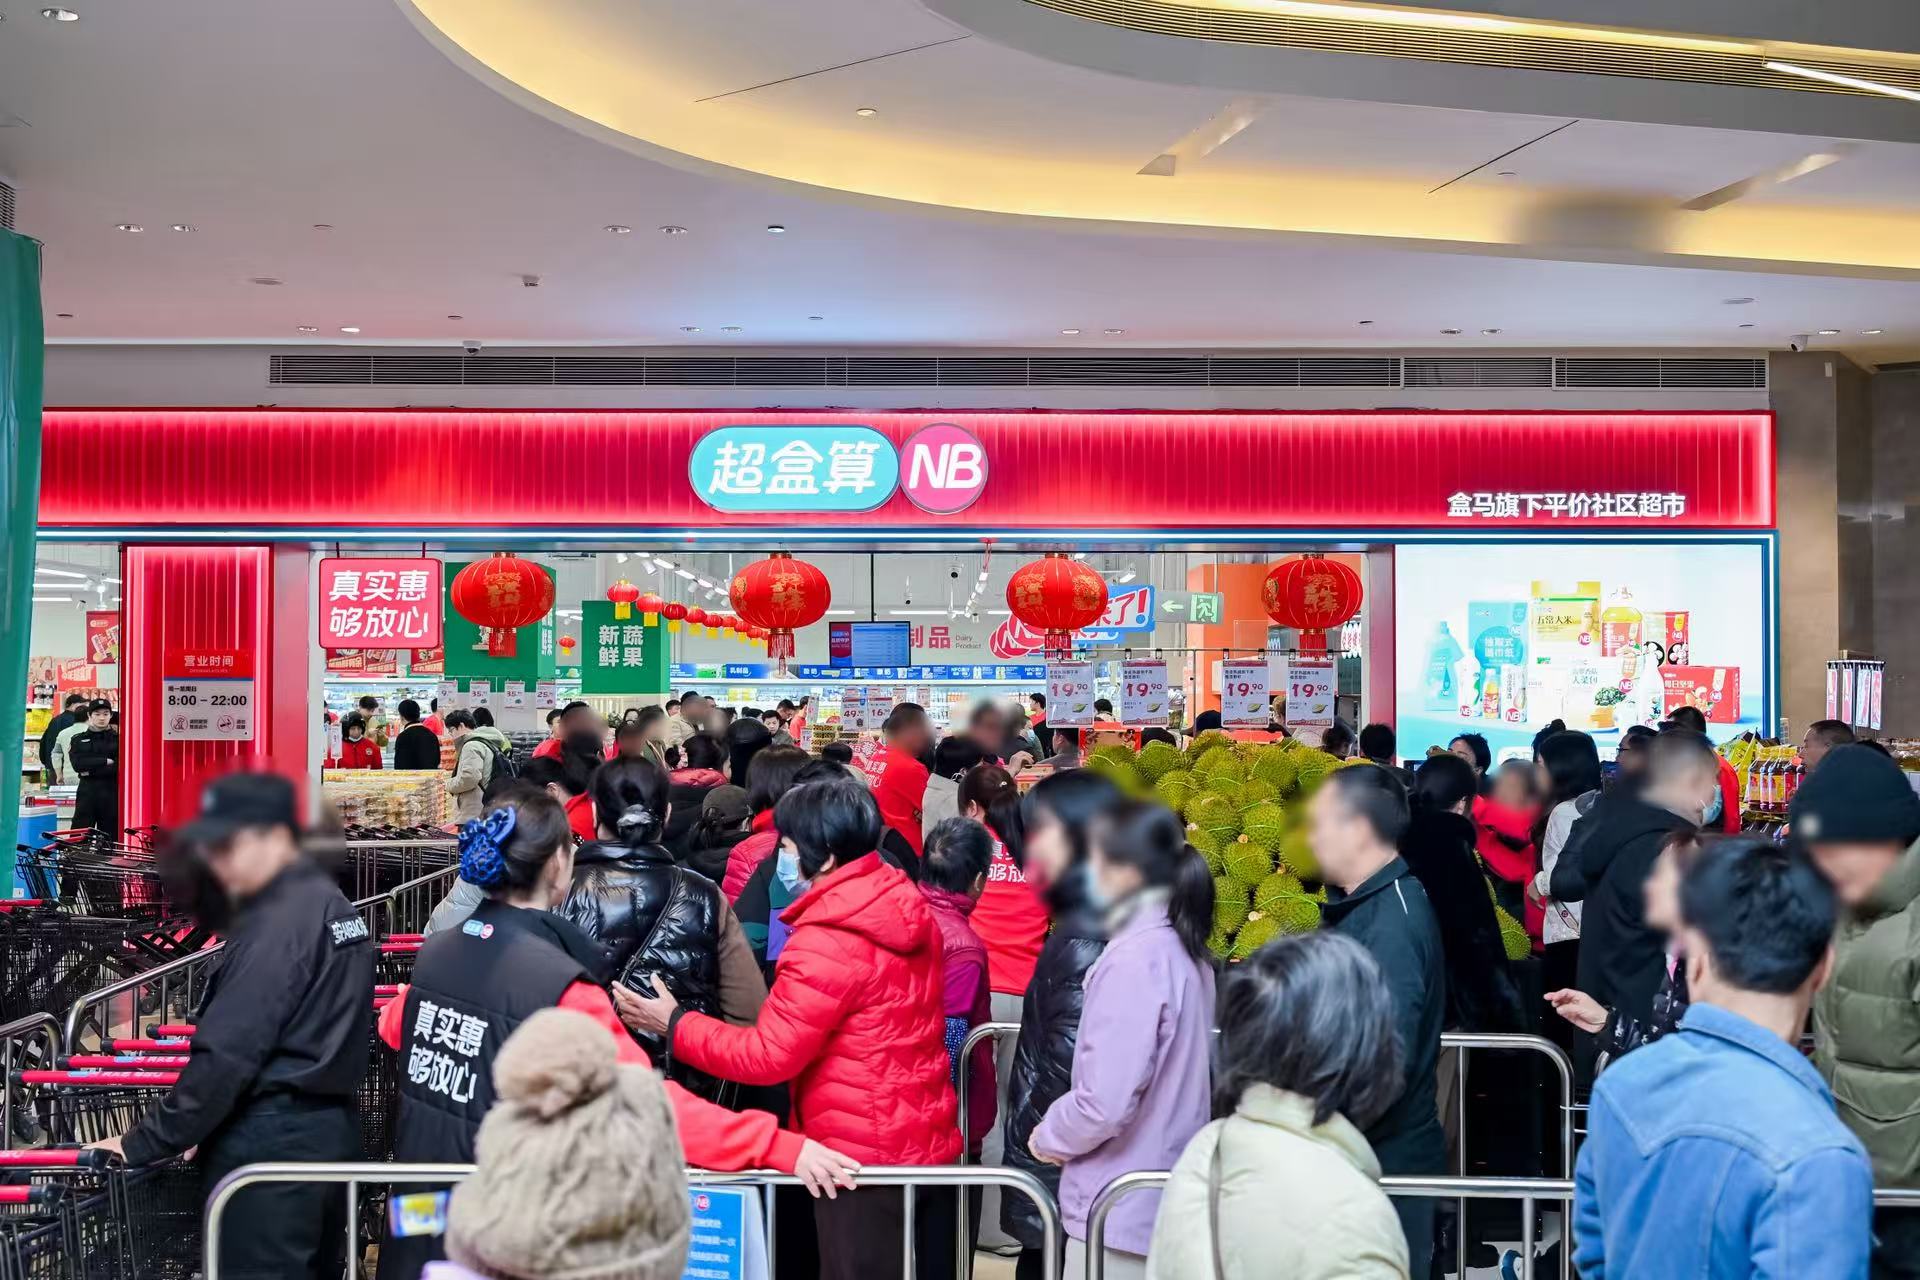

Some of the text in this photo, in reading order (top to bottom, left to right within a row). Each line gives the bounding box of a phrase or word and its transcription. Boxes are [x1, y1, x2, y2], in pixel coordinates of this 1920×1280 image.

[708, 439, 881, 495] 超盒算
[908, 443, 983, 490] NB
[1447, 492, 1686, 518] 盒马旗下平价社区超市
[328, 569, 430, 602] 真实惠
[328, 605, 430, 639] 够放心
[955, 634, 973, 642] Dairy
[184, 655, 234, 667] 营业时间
[1051, 683, 1088, 697] 19.90
[1126, 683, 1163, 697] 19.90
[1226, 682, 1264, 697] 19.90
[1291, 683, 1329, 698] 19.90
[168, 695, 197, 706] 8:00
[211, 695, 247, 706] 22:00
[1506, 712, 1520, 720] NB
[413, 1000, 489, 1058] 真实惠
[408, 1044, 478, 1104] 够放心
